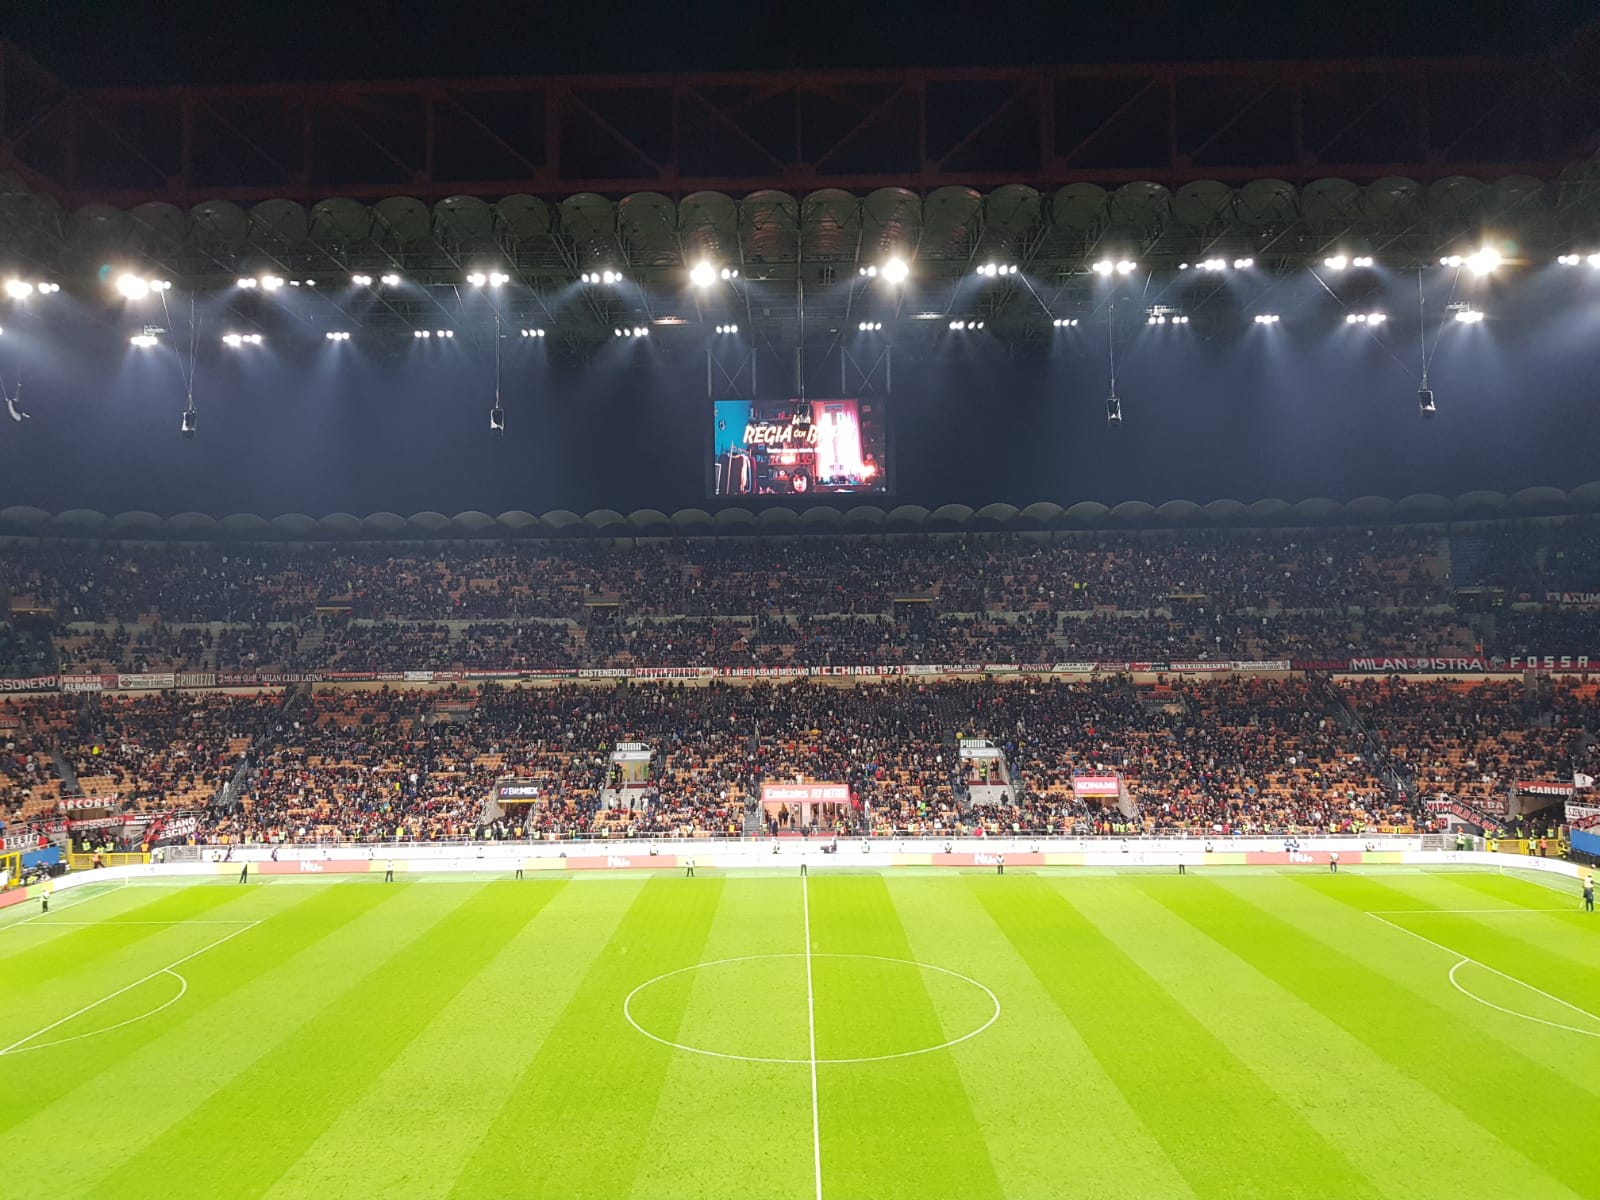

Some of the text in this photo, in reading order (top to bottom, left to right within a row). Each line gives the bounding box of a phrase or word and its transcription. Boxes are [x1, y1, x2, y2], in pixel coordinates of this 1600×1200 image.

[743, 424, 793, 445] REGIA
[1352, 658, 1483, 671] MILAN ISTRA
[1510, 655, 1589, 668] FOSSA
[636, 668, 699, 678] CASTELFIDARDO
[752, 668, 778, 676] BASSANO
[779, 667, 809, 676] BRESCIANO
[878, 665, 901, 675] 1973
[261, 673, 281, 682] MILAN
[282, 673, 299, 681] CLUB
[301, 673, 323, 682] LATINA
[64, 683, 102, 691] ALBANIA
[616, 742, 641, 751] PUMA
[960, 739, 986, 748] PUMA
[1077, 781, 1116, 789] KONAMI
[765, 788, 809, 799] Emirates
[1529, 785, 1573, 796] CARUGO
[59, 797, 110, 811] ARCORE
[164, 817, 196, 830] SSANO
